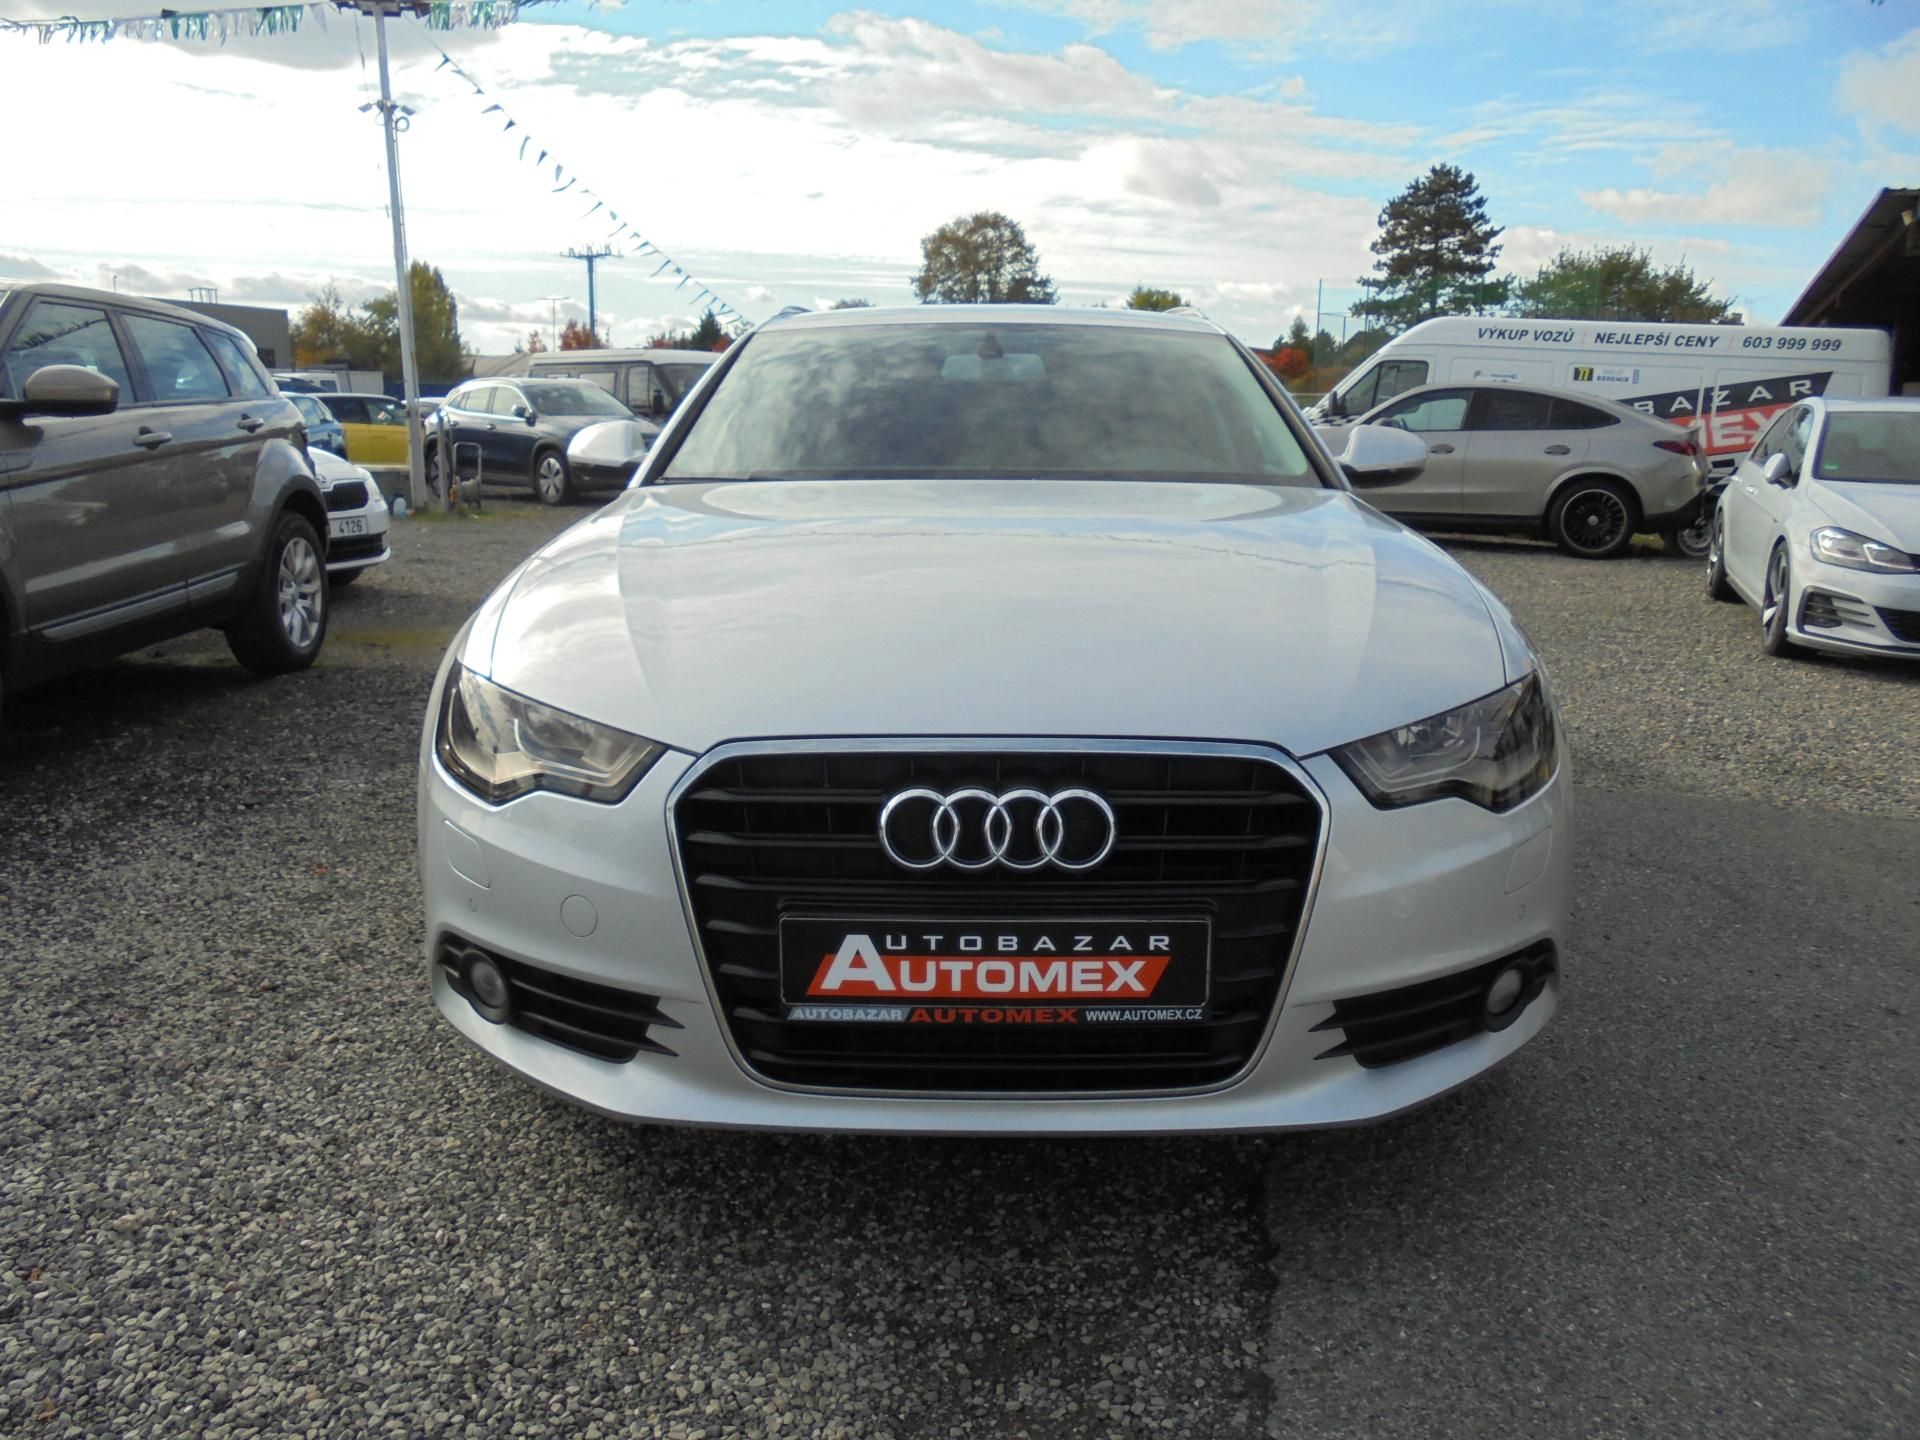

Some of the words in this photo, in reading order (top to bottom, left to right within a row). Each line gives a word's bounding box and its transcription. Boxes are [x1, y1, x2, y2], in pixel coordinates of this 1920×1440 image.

[1477, 325, 1529, 341] VÝKUP
[1533, 327, 1576, 343] VOZŮ
[1594, 331, 1672, 346] NEJLEPŠÍ
[1674, 334, 1720, 348] CENY
[1742, 336, 1773, 349] 603
[1776, 337, 1807, 350] 999
[1811, 338, 1842, 351] 999
[339, 520, 363, 534] 4126
[820, 934, 1147, 993] AUTOMEX
[792, 1006, 903, 1021] AUTOBAZAR
[910, 1007, 1078, 1024] AUTOMEX
[1085, 1008, 1203, 1022] WWW.AUTOMEX.CZ
